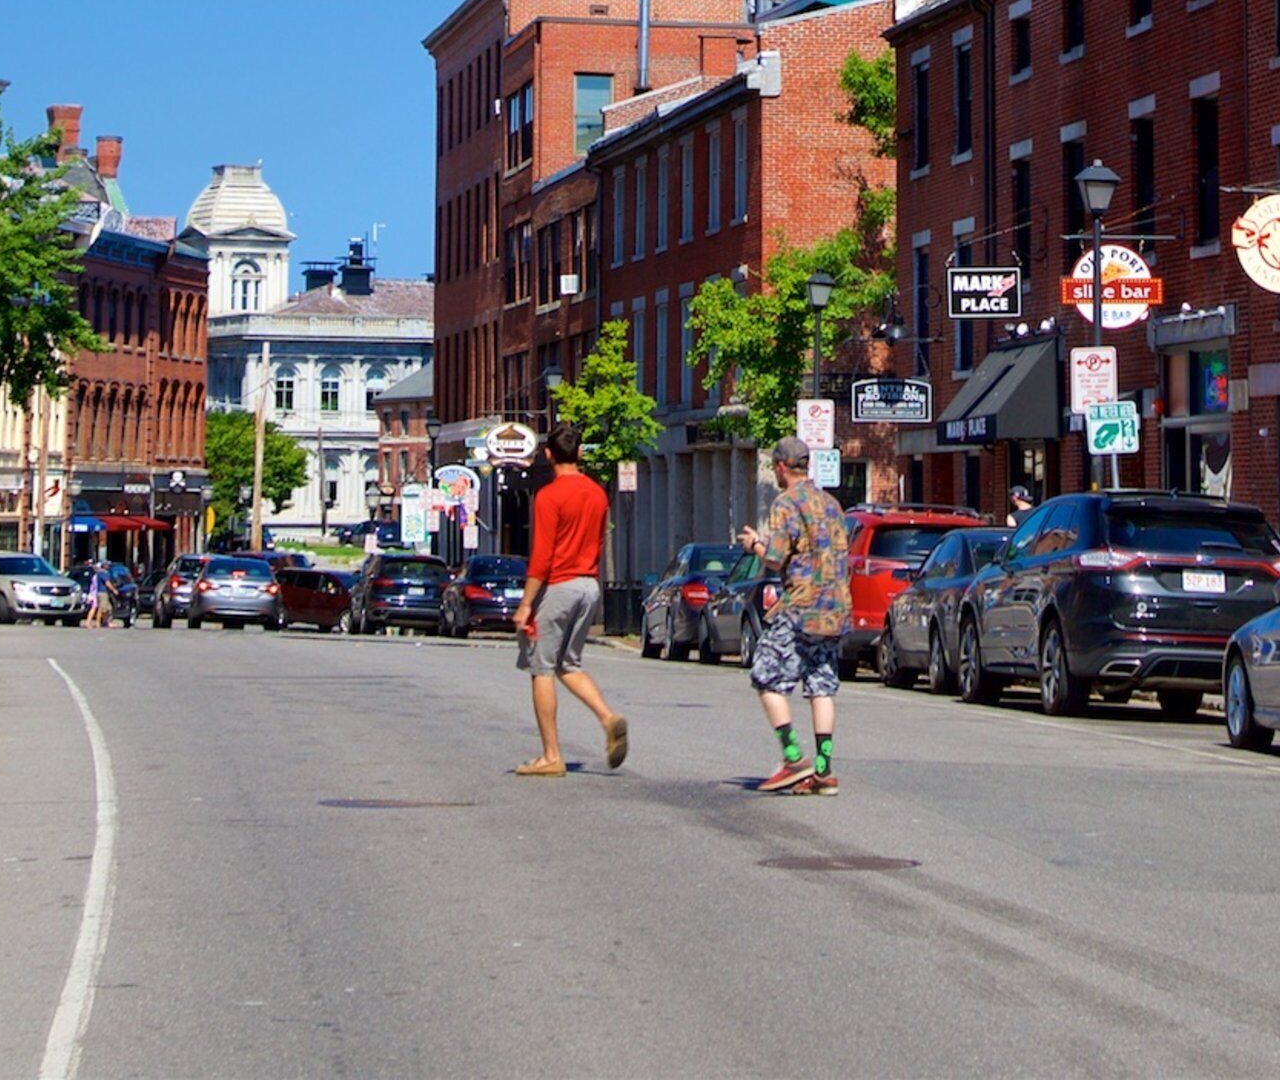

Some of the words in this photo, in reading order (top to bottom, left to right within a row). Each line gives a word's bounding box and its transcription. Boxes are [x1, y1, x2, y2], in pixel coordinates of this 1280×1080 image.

[1111, 248, 1144, 273] PORT
[1073, 284, 1115, 299] slie
[1121, 284, 1151, 299] bar
[961, 298, 1009, 311] PLACE
[858, 392, 925, 401] PROVISIONS
[864, 385, 919, 395] CENTRAL
